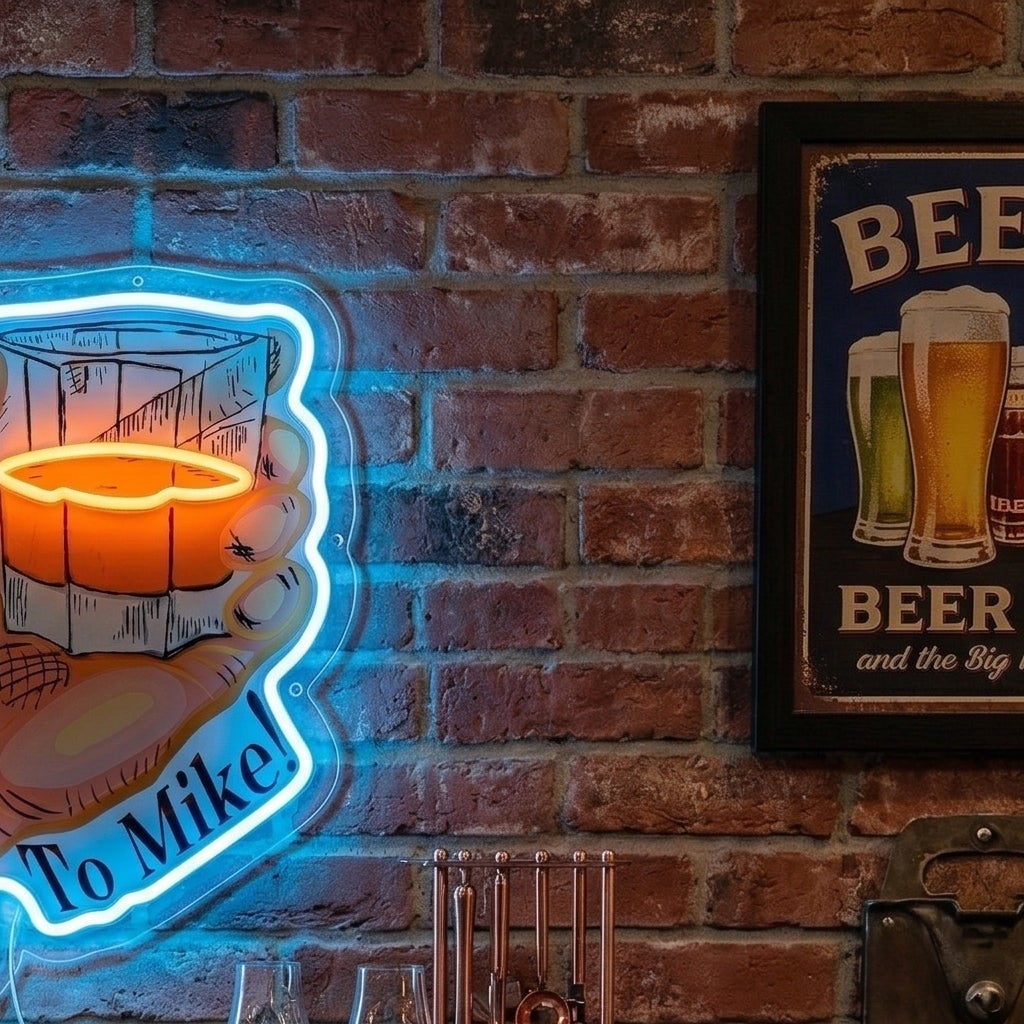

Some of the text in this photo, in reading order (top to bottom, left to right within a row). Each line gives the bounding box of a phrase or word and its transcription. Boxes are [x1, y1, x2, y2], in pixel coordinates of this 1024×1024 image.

[837, 584, 1017, 635] BEER
[856, 645, 912, 672] and
[915, 645, 957, 671] the
[964, 644, 1012, 681] Big
[16, 690, 296, 912] To Mike!
